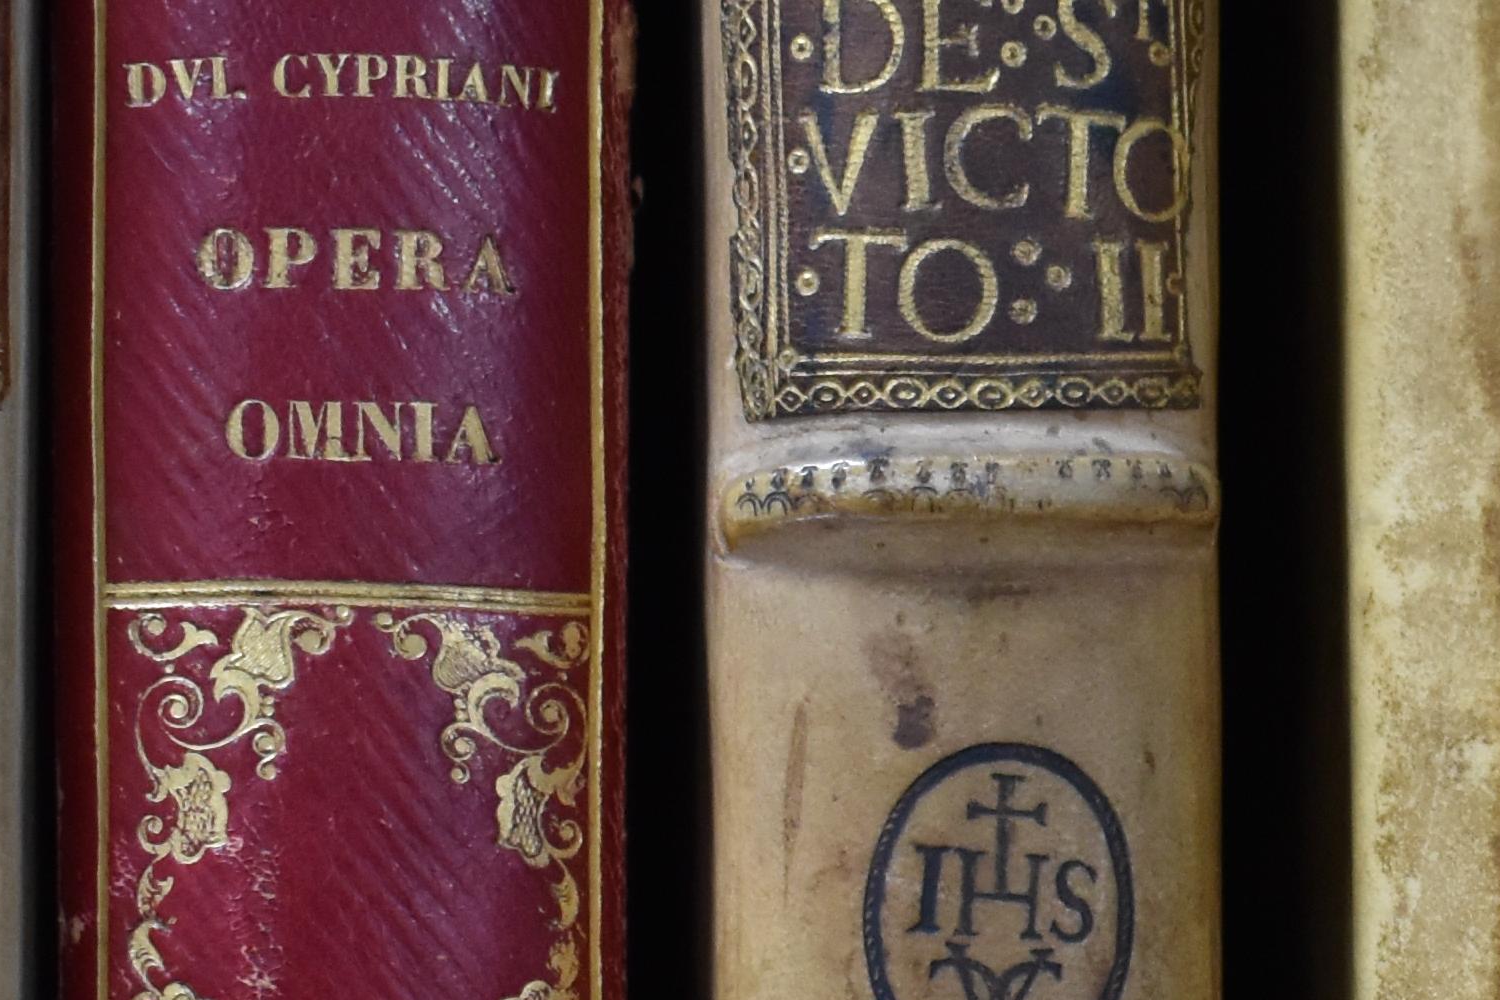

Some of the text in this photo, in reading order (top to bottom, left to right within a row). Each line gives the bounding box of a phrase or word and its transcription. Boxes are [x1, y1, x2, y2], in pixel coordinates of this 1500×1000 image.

[272, 53, 560, 113] CYPRIANI
[800, 103, 1188, 221] VICTO
[197, 227, 516, 295] OPERA
[226, 399, 502, 464] OMNIA
